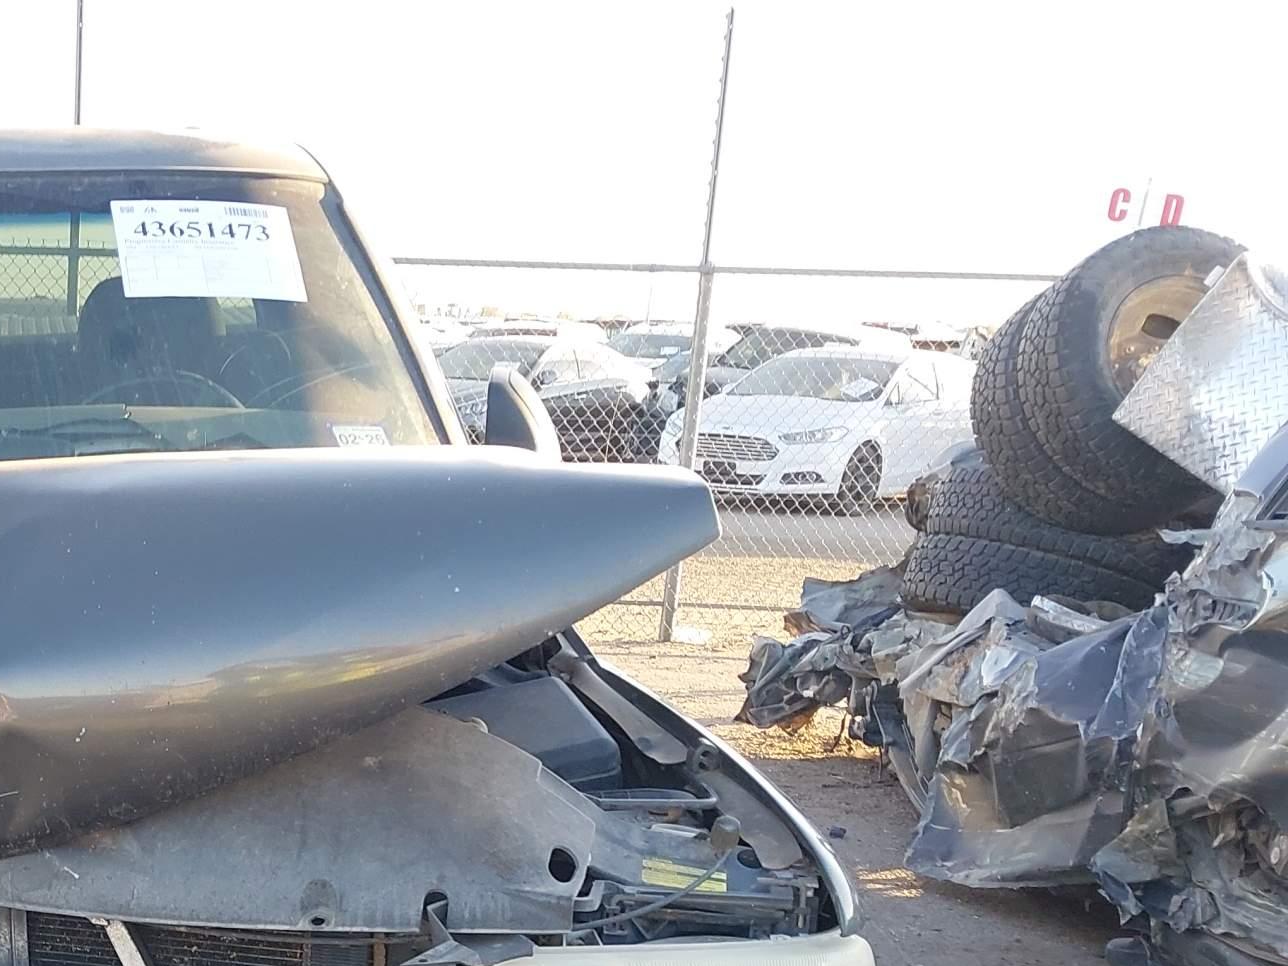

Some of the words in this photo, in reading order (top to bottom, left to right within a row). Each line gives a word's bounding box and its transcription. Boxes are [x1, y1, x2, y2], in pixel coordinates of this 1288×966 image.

[1108, 188, 1131, 221] C
[1160, 193, 1184, 228] D
[133, 220, 270, 242] 43651473
